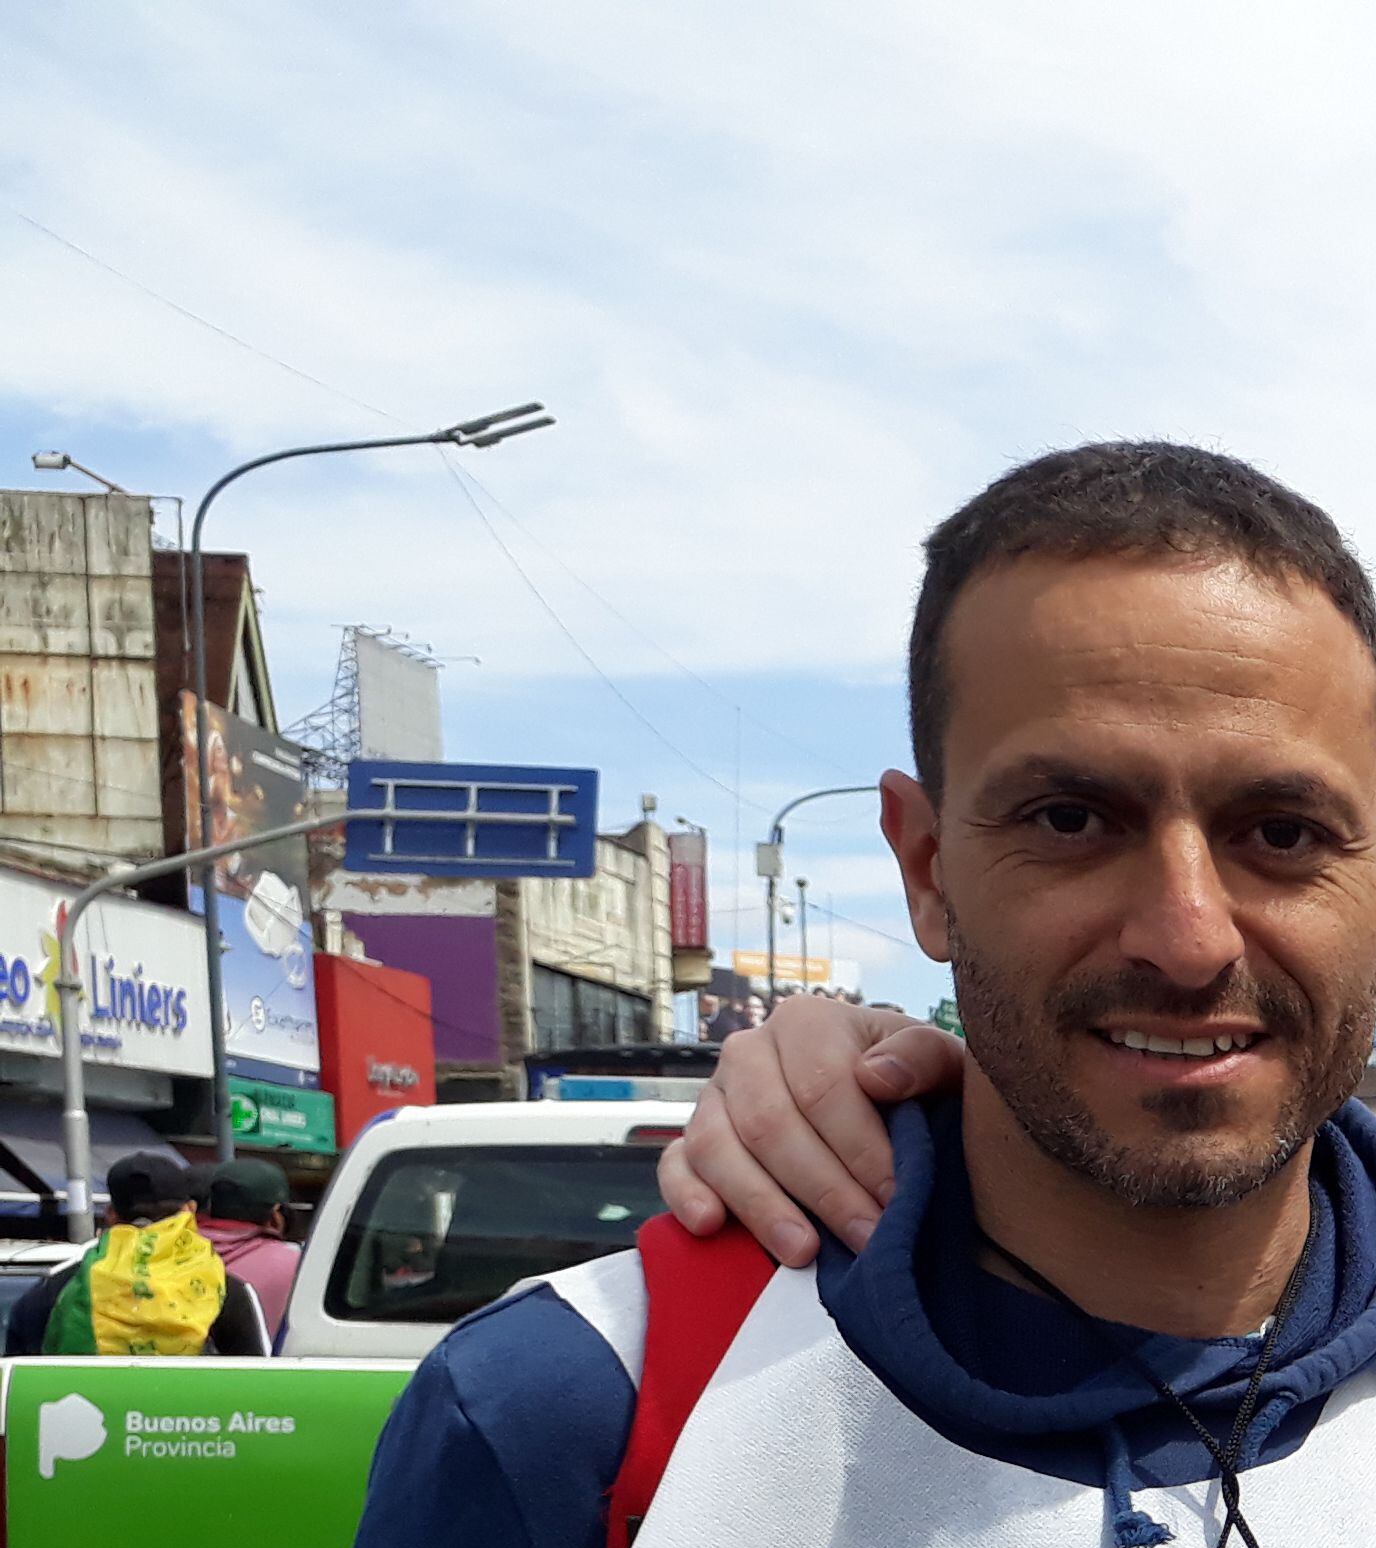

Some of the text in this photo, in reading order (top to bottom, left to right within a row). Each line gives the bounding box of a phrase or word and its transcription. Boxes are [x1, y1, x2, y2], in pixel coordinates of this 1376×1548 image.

[90, 953, 187, 1033] Liniers
[125, 1411, 296, 1433] Buenos Aires
[126, 1434, 236, 1458] Provincia
